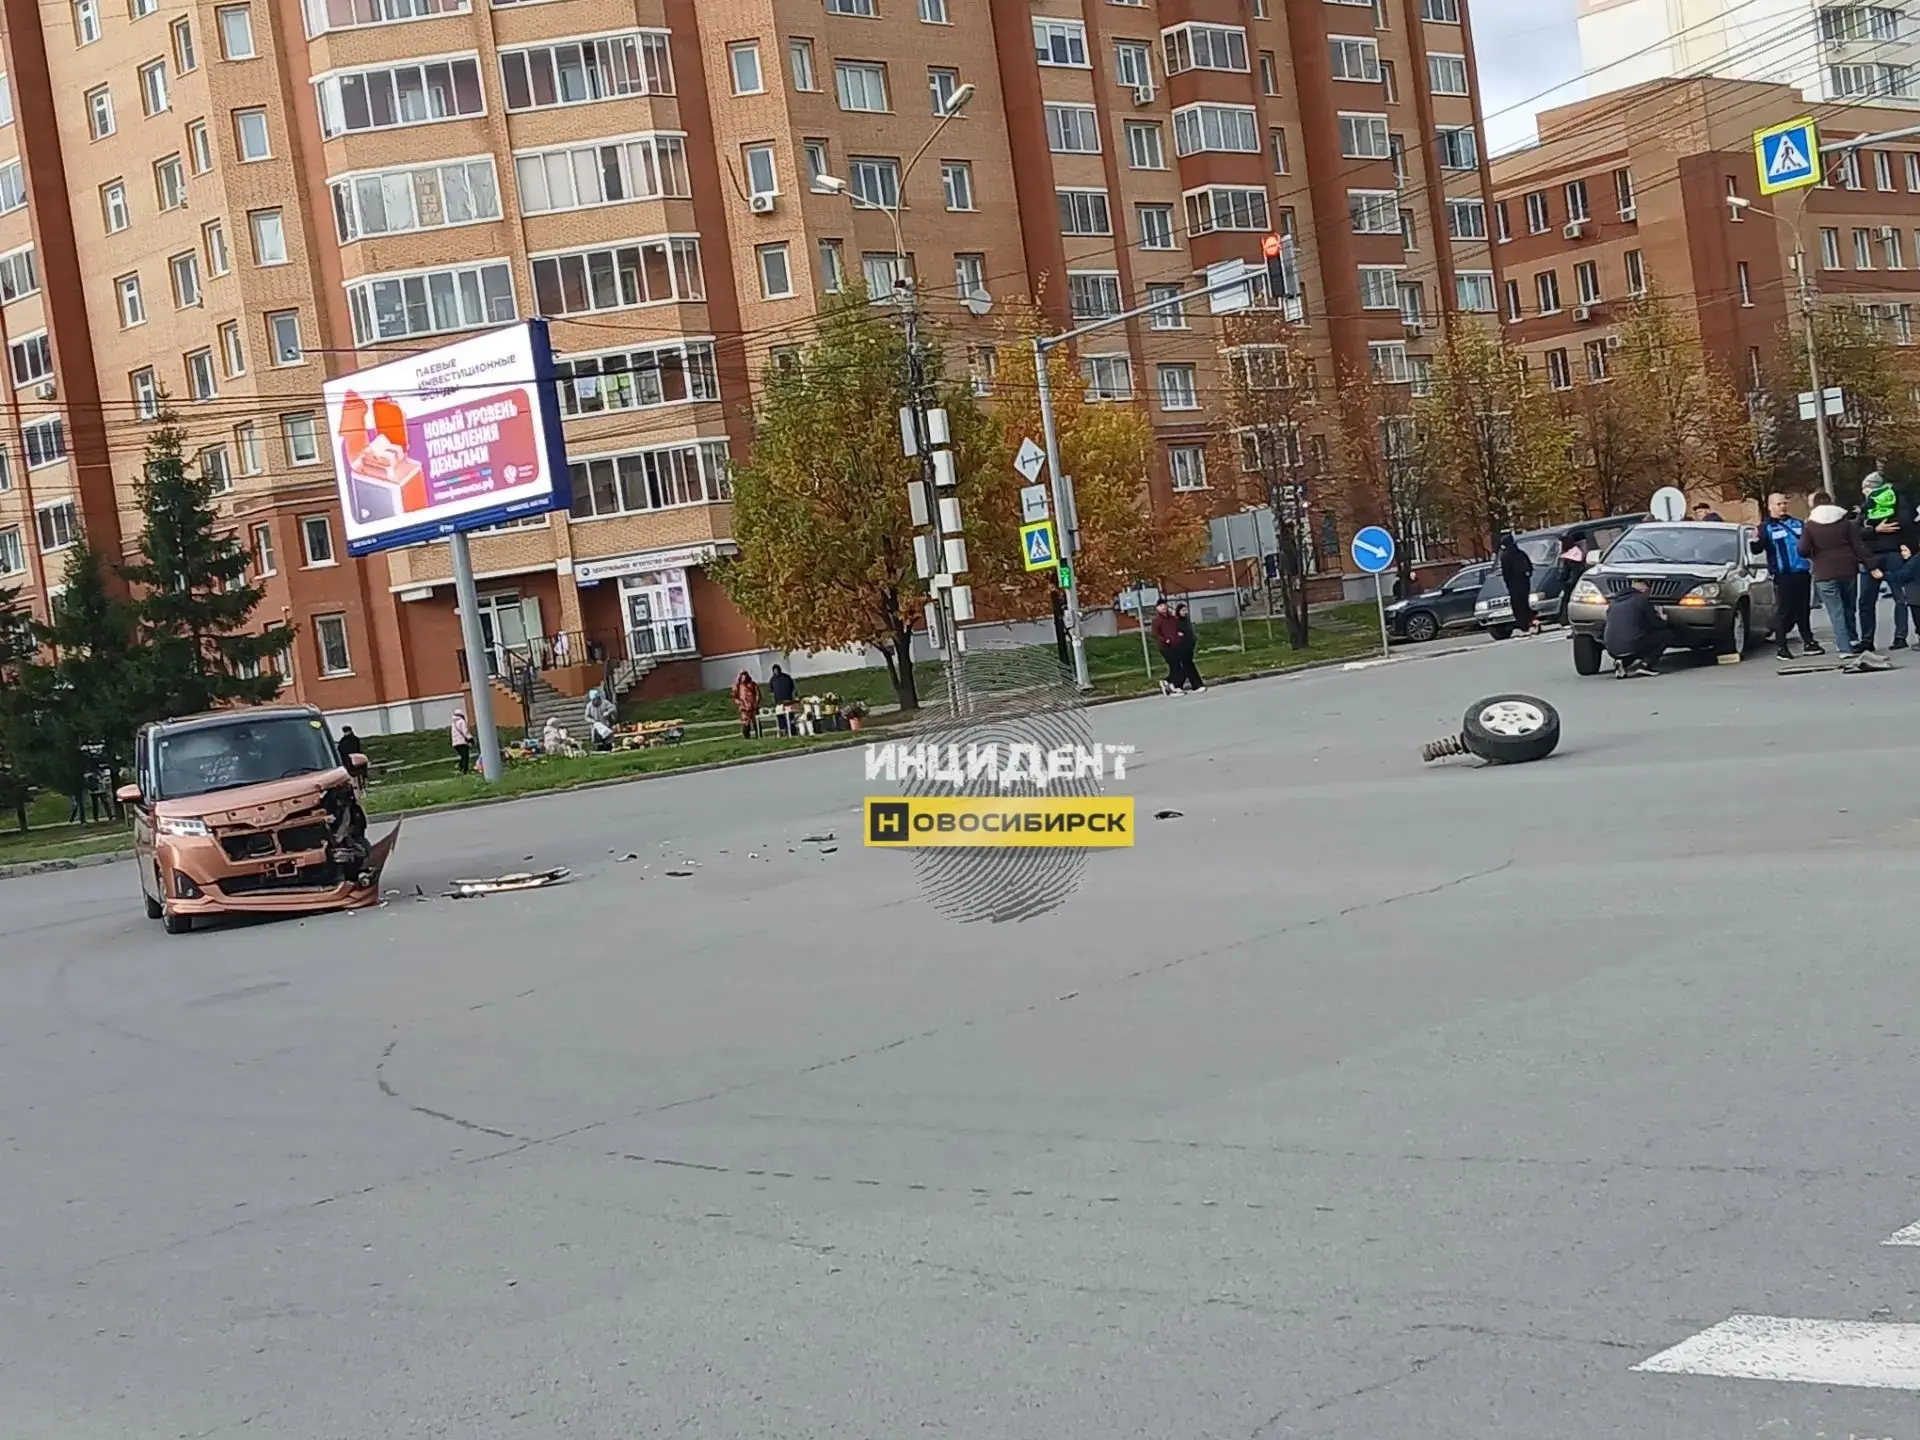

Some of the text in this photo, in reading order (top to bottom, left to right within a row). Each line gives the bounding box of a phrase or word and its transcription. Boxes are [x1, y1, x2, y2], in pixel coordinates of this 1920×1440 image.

[416, 358, 457, 378] ПАЕВЫЕ
[418, 354, 516, 389] ИНВЕСТИЦИОННЫЕ
[423, 400, 518, 439] НОВЫЙ УРОВЕНЬ
[426, 424, 499, 458] УПРАВЛЕНИЯ
[429, 446, 490, 478] ДЕНЬГАМИ
